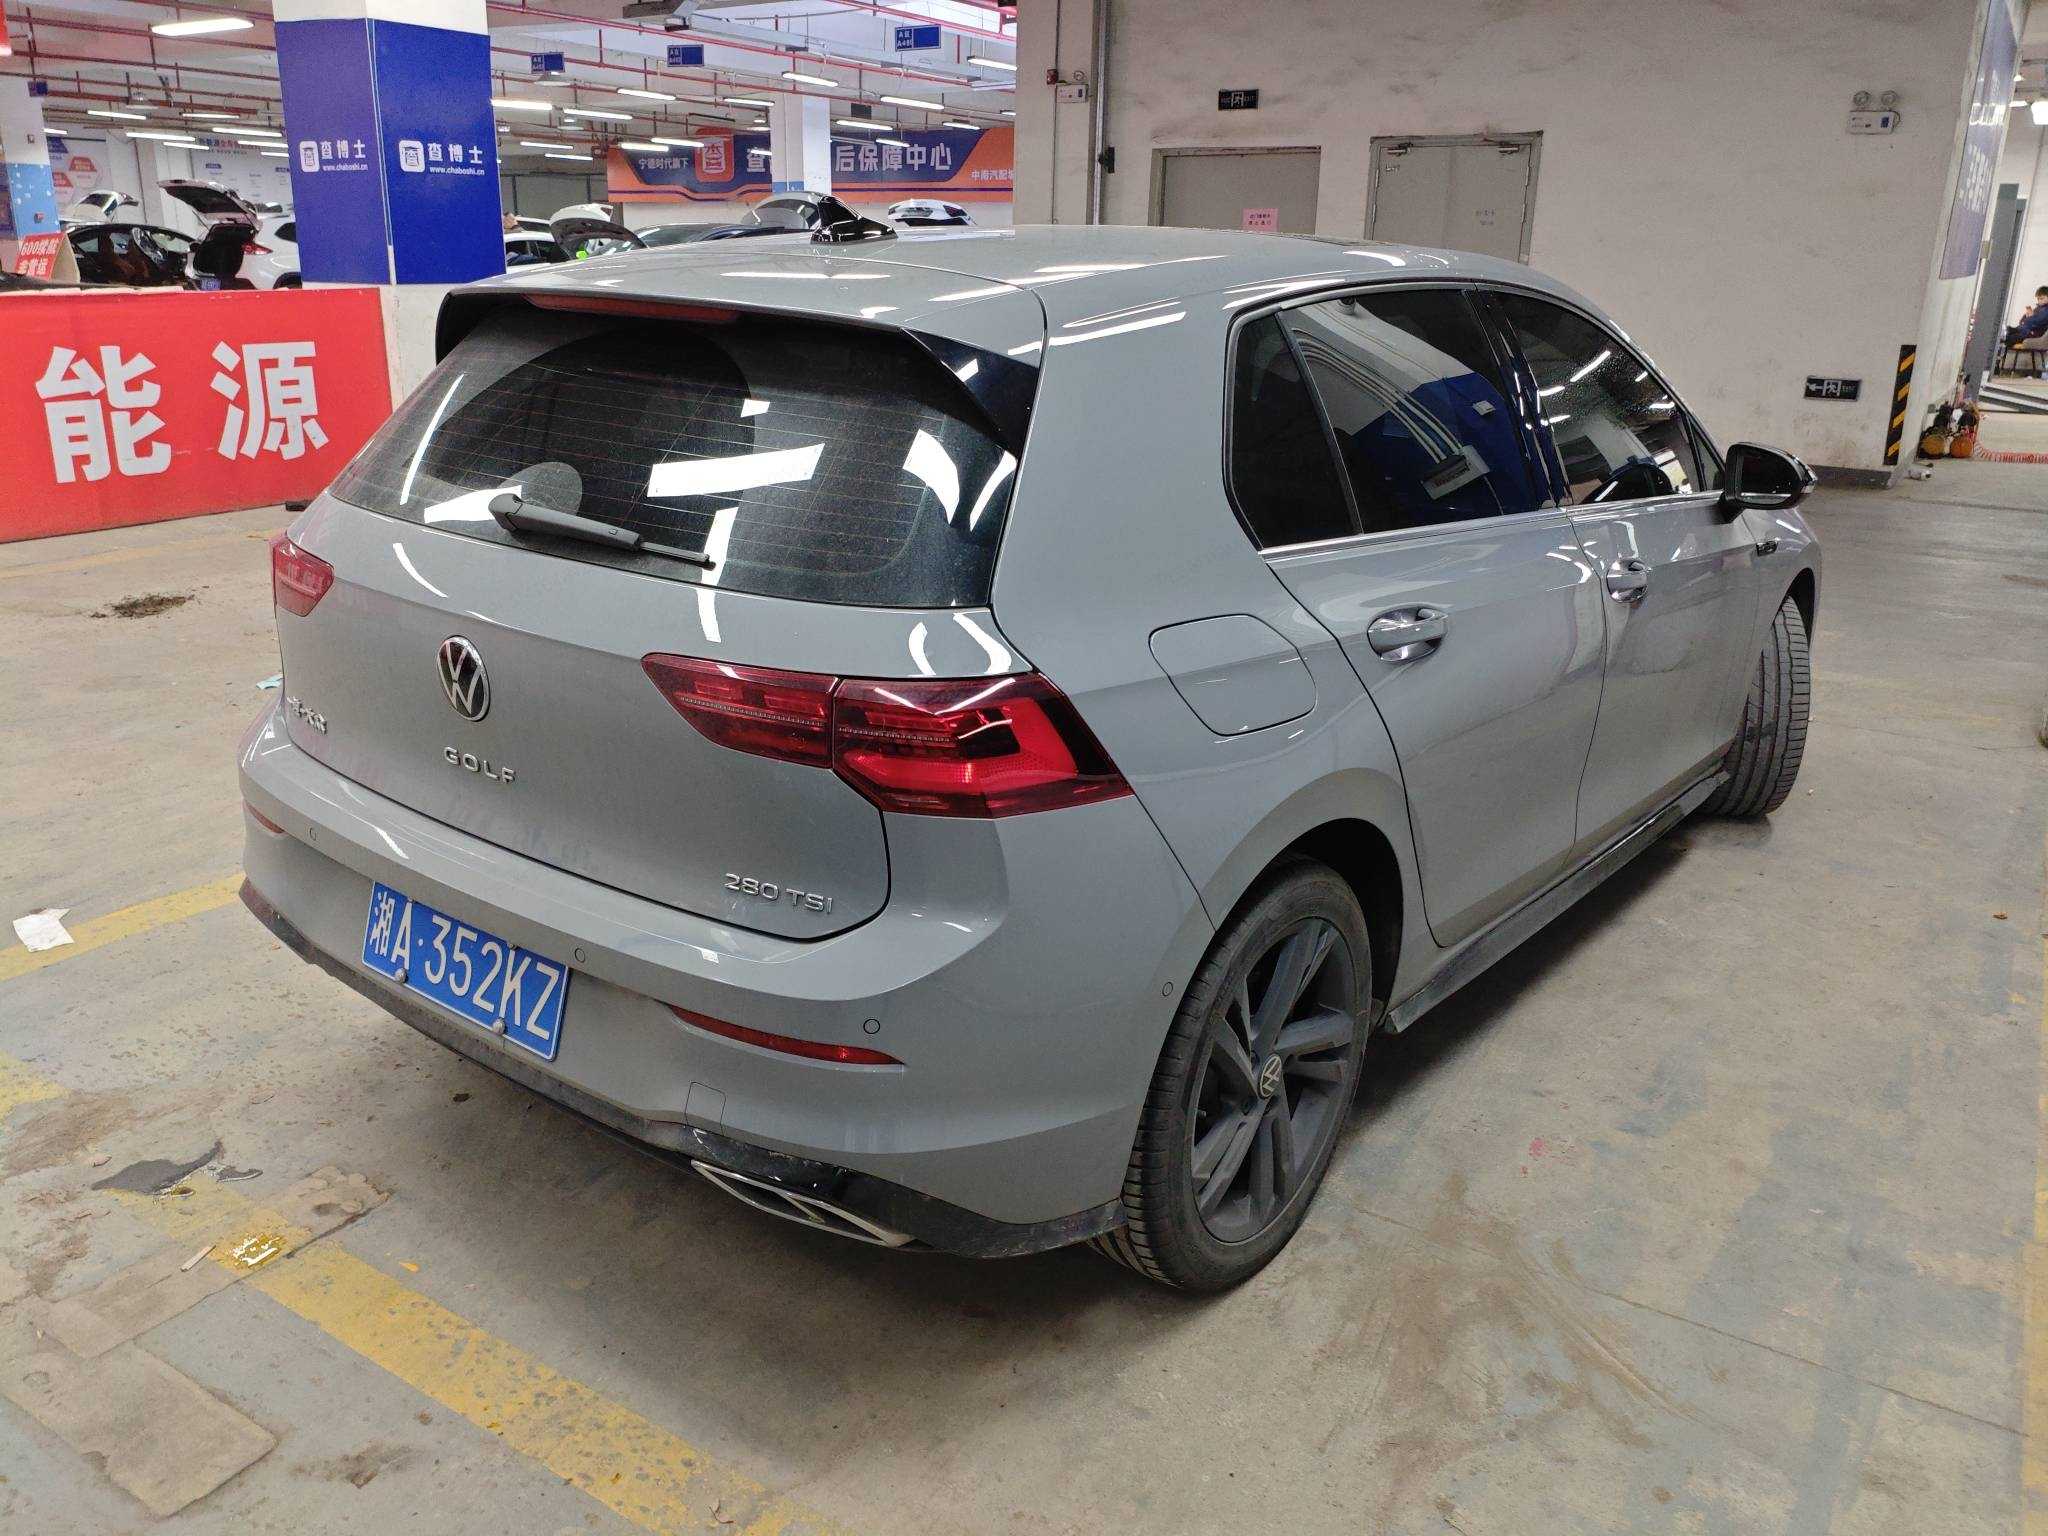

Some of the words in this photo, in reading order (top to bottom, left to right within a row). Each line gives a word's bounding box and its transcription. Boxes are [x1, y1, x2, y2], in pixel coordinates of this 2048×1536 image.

[320, 139, 367, 160] 查博士
[427, 142, 483, 164] 查博士
[835, 143, 952, 172] 后保障中心
[322, 163, 369, 172] www.chaboshi.cn
[429, 166, 485, 176] www.chaboshi.cn
[35, 341, 330, 484] 能源
[444, 746, 516, 784] GOLF
[724, 872, 779, 900] 280
[785, 888, 833, 914] TSI
